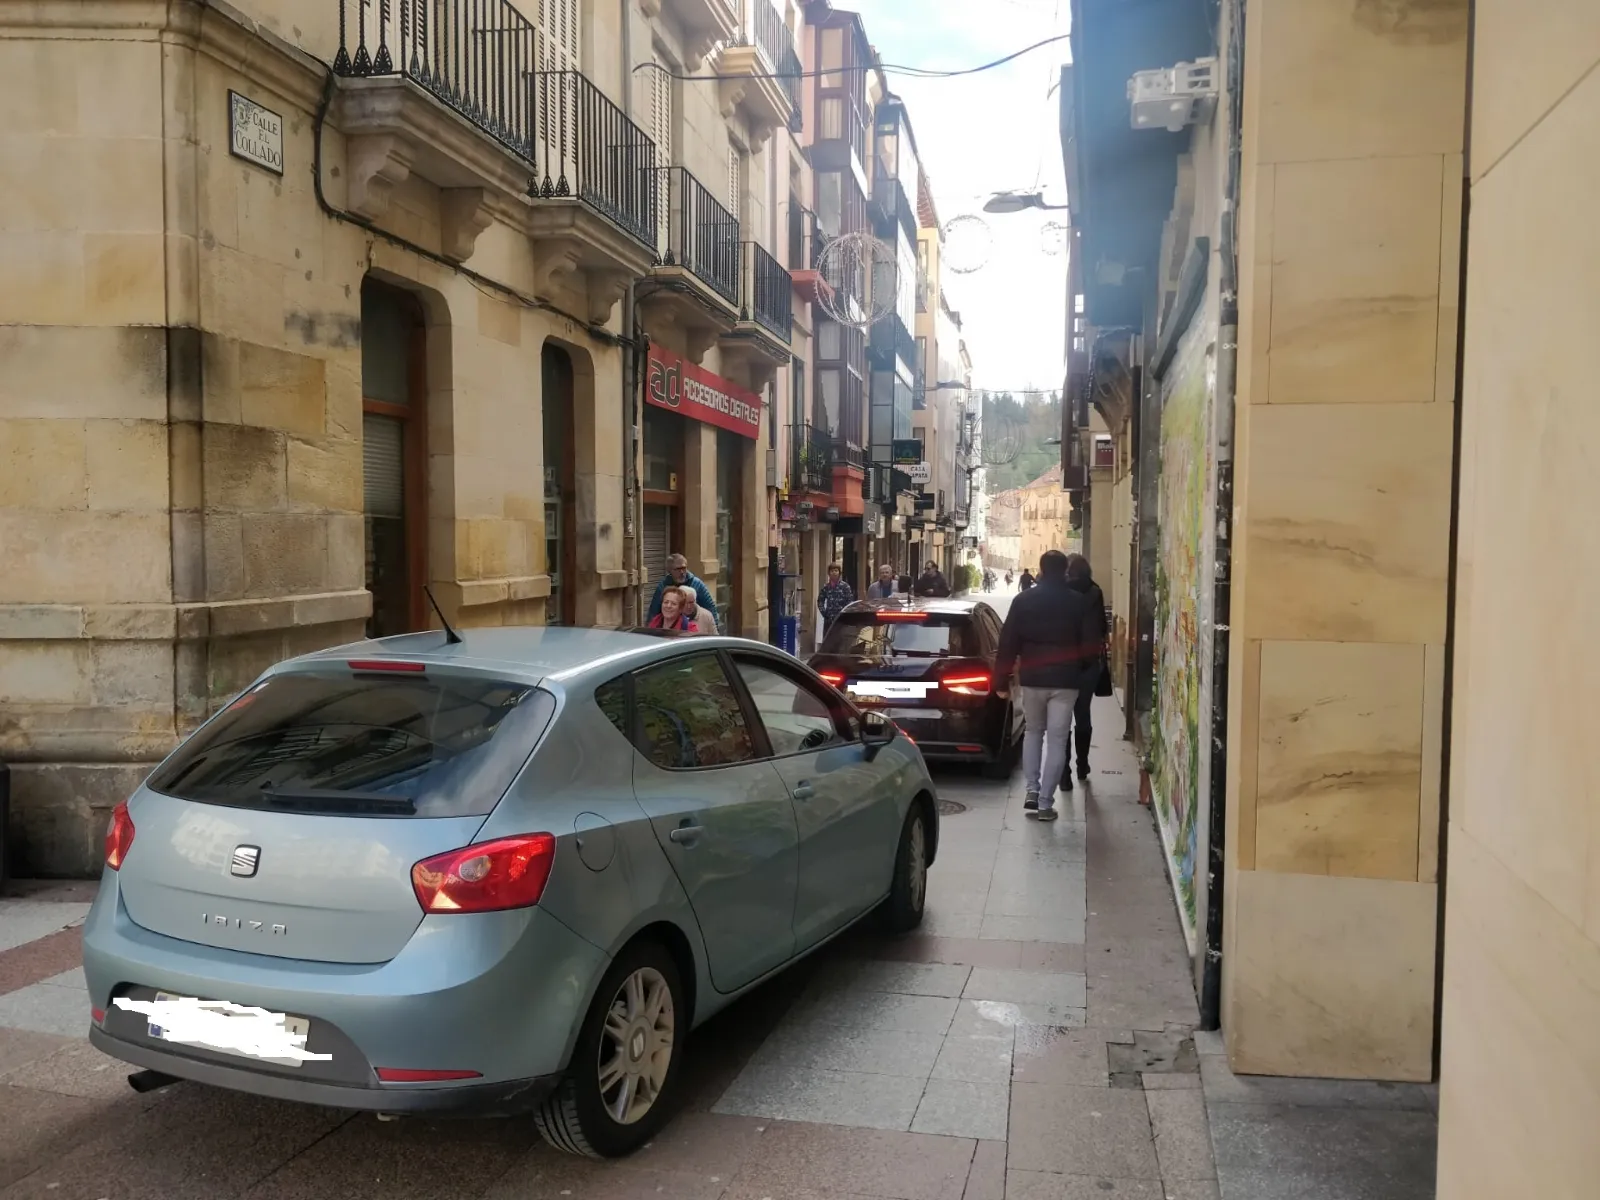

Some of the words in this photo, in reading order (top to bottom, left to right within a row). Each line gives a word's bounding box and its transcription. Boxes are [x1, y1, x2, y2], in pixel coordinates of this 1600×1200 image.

[253, 112, 278, 136] CALLE
[258, 128, 270, 144] EL
[236, 129, 281, 167] COLLADO
[649, 357, 681, 408] ad
[683, 377, 729, 414] ACCESORIOS
[729, 397, 759, 426] DIGITALES
[202, 913, 287, 935] IBIZA
